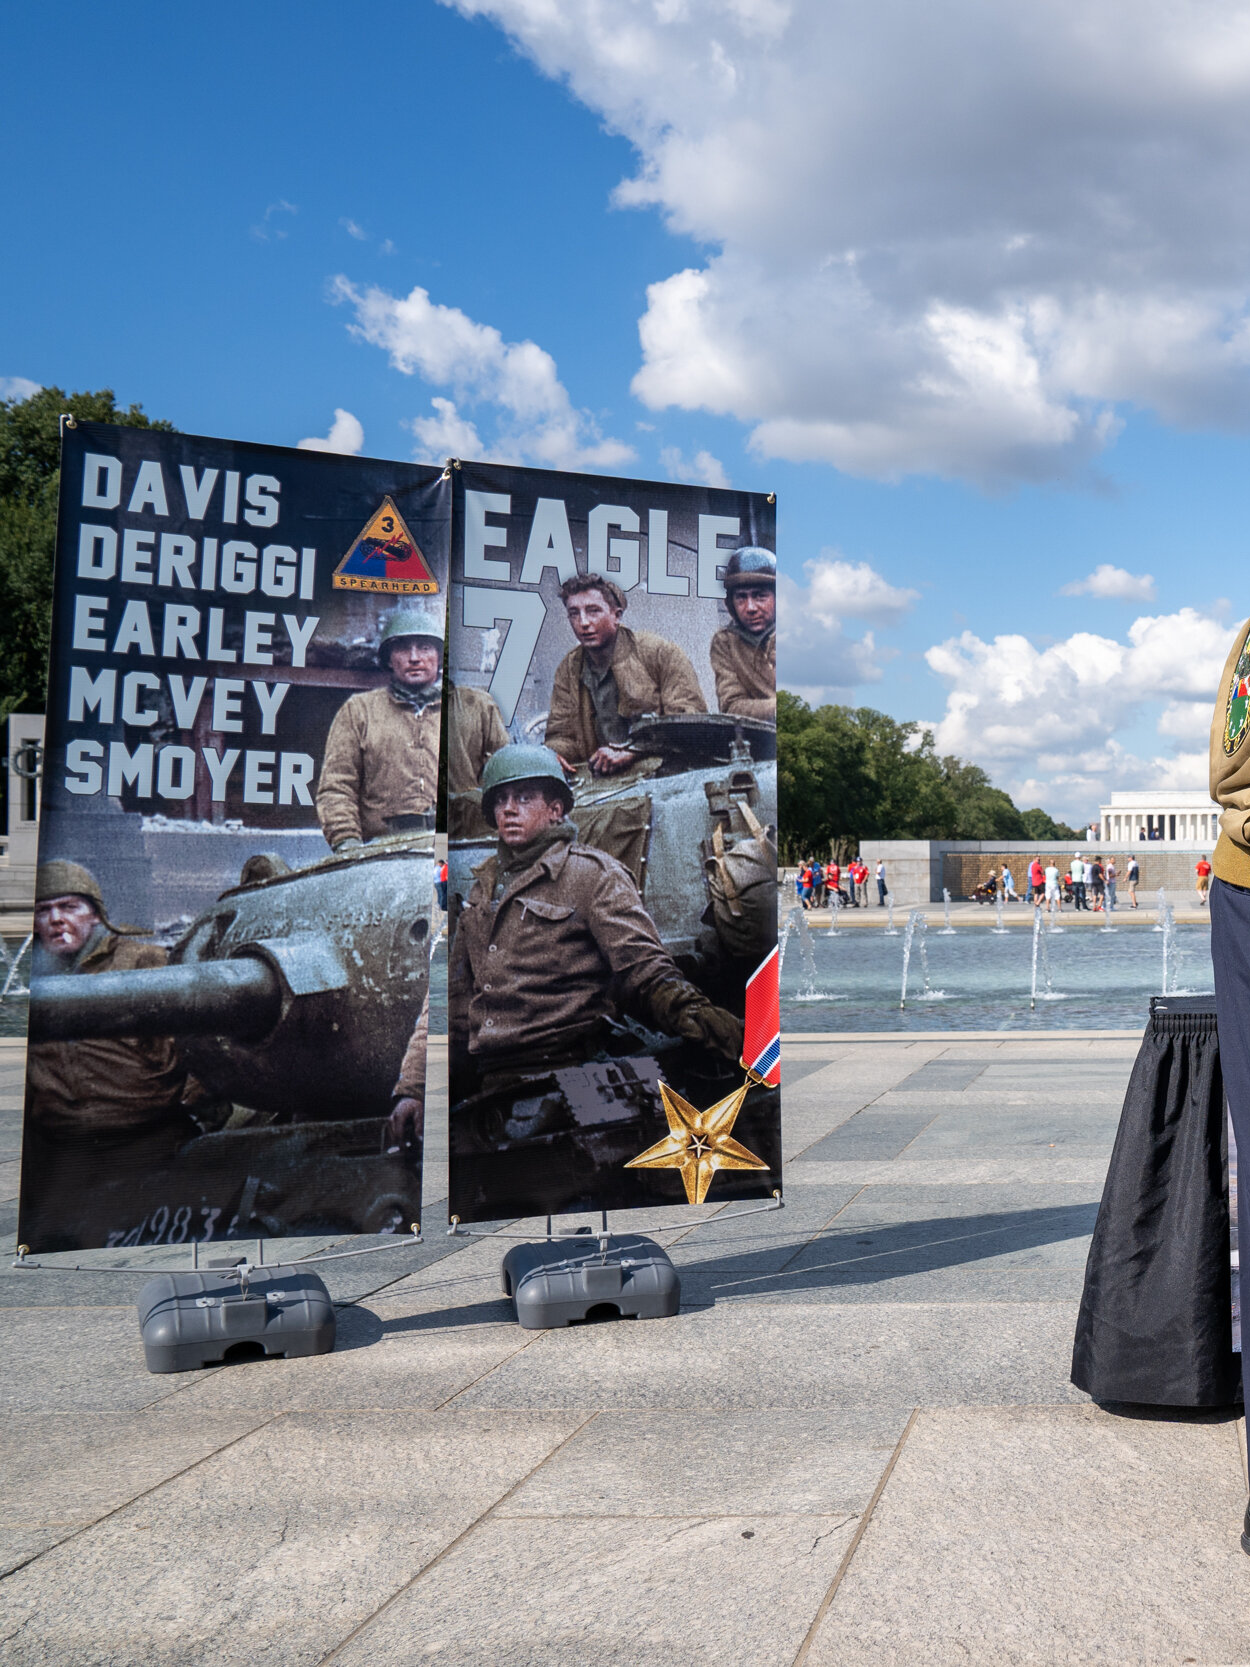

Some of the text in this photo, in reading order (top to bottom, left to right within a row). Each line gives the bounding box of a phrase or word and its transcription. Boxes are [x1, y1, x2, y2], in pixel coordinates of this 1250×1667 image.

[81, 451, 282, 528] DAVIS
[381, 516, 394, 533] 3
[76, 522, 317, 600] DERIGGI
[463, 489, 740, 599] EAGLE
[340, 577, 431, 592] SPEARHEAD
[72, 594, 321, 668] EARLEY
[462, 585, 548, 728] 7
[67, 665, 291, 736] MCVEY
[64, 739, 316, 807] SMOYER
